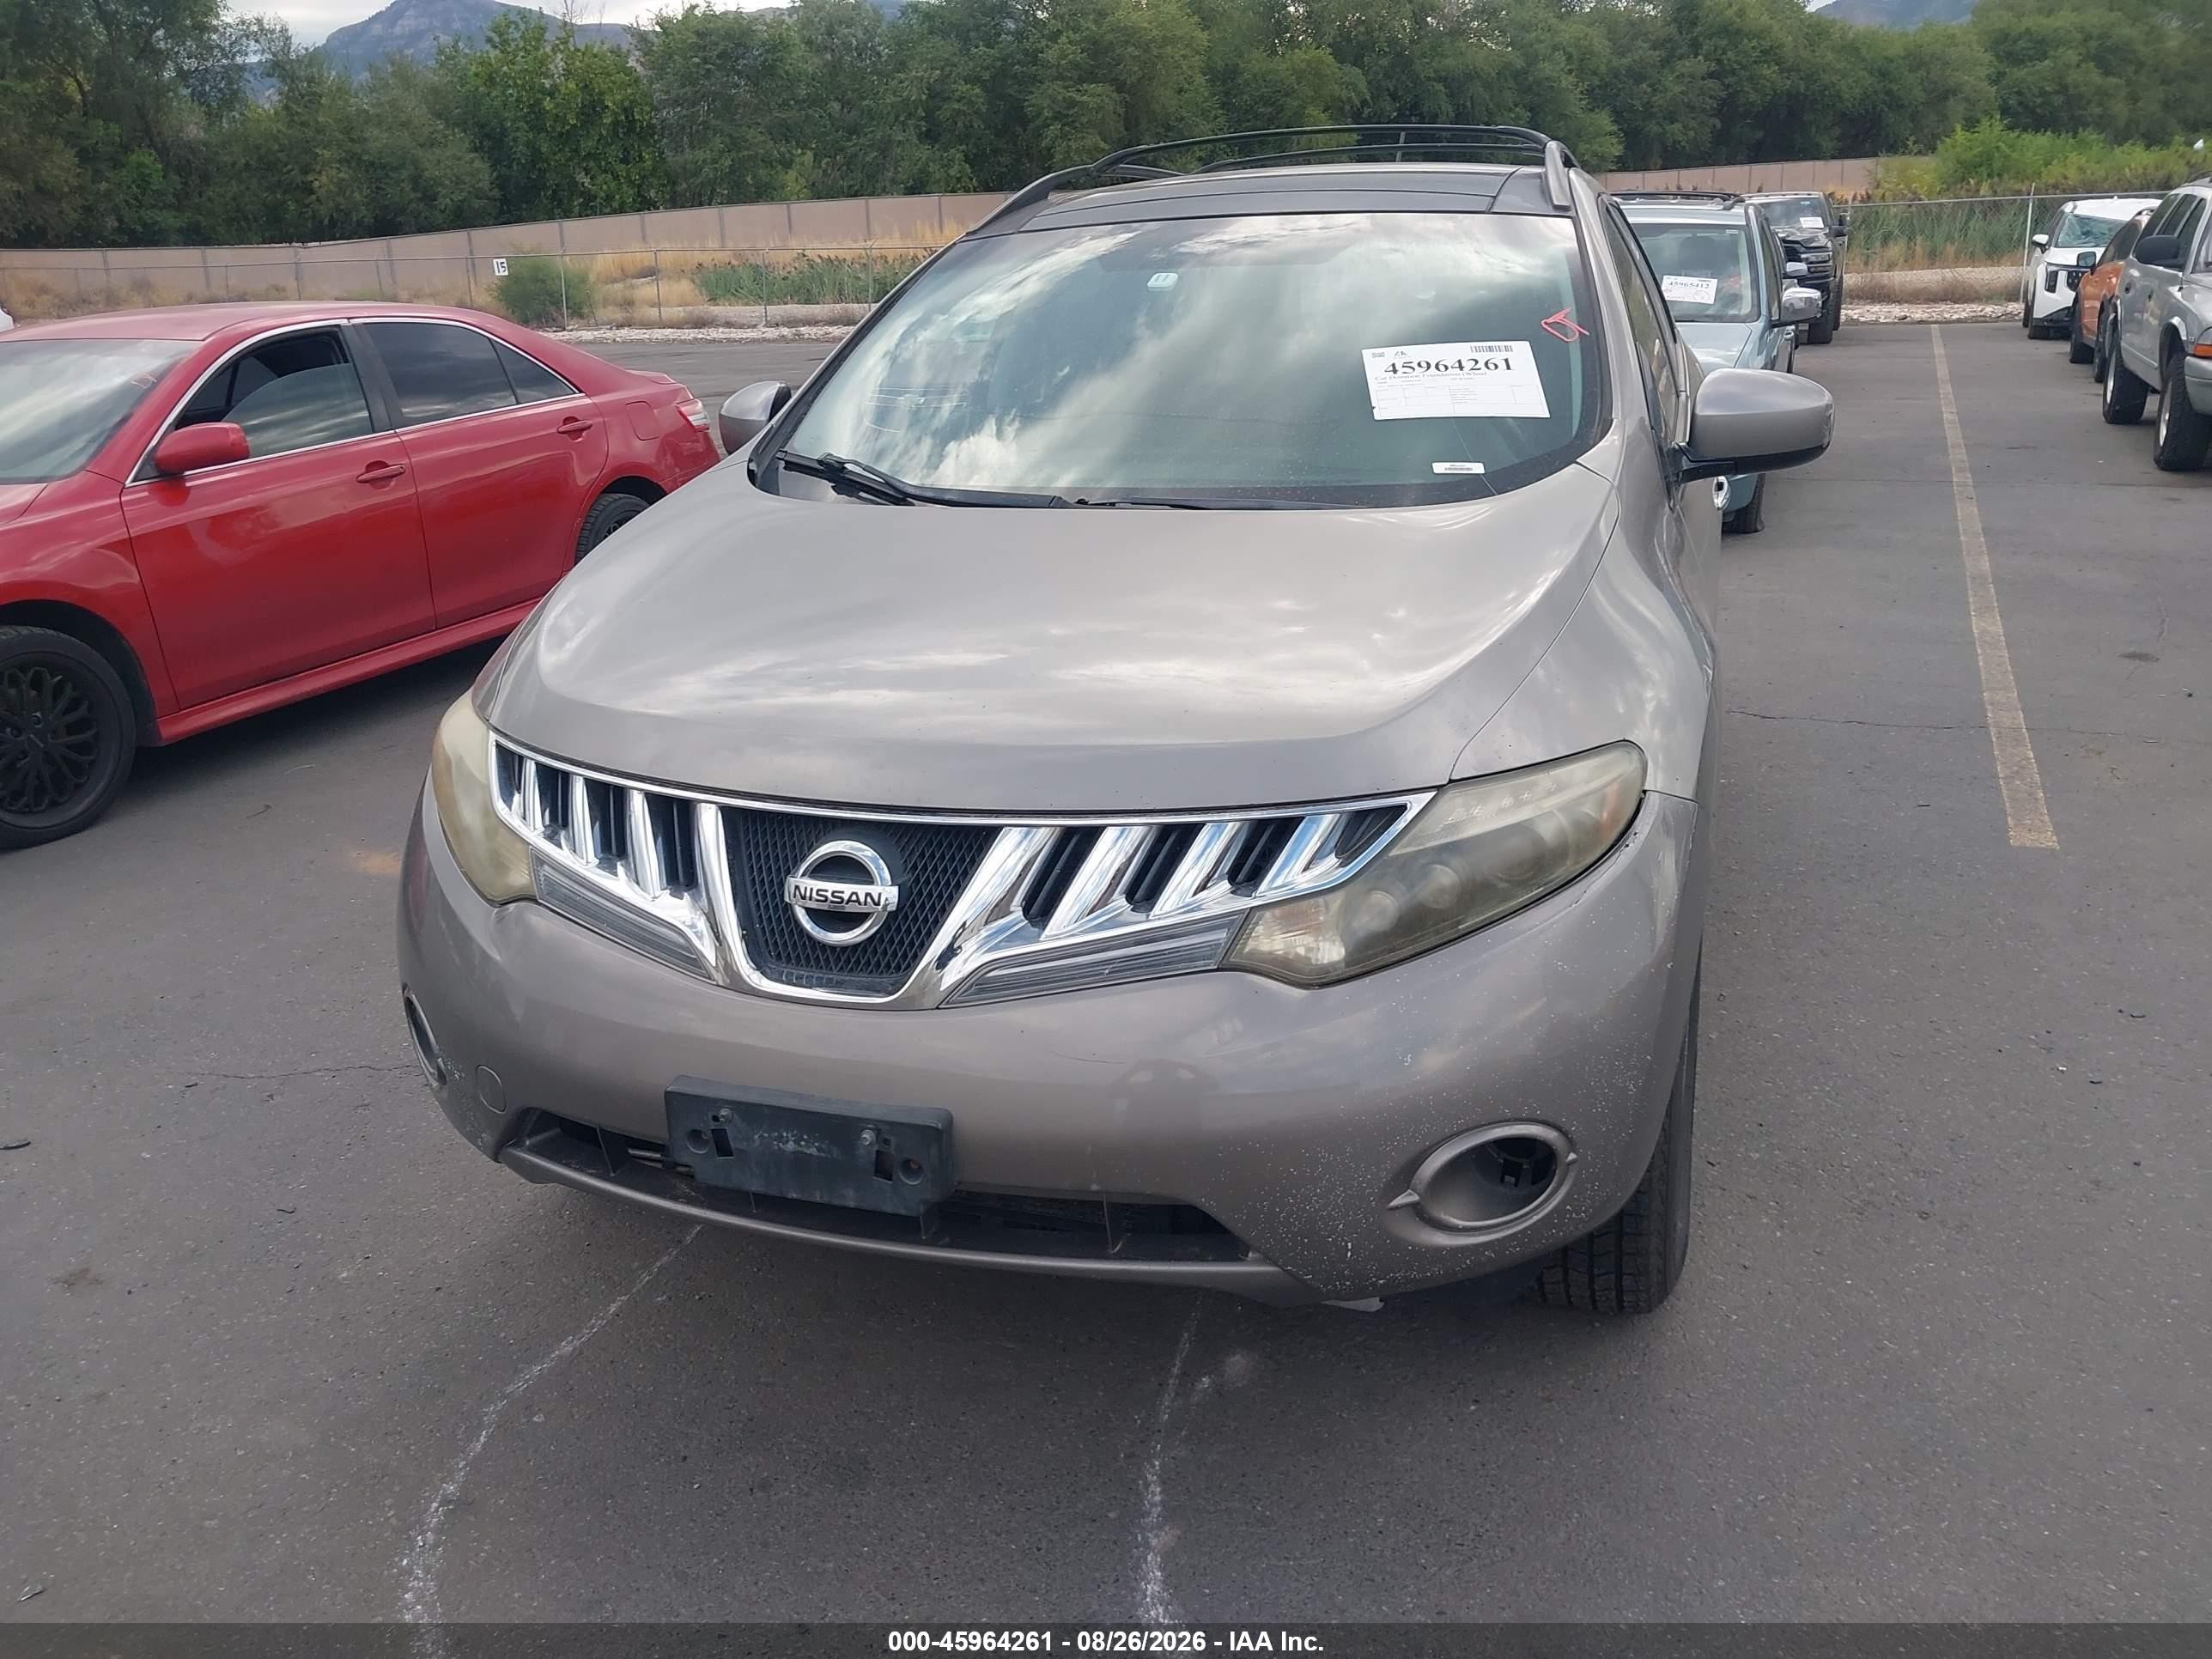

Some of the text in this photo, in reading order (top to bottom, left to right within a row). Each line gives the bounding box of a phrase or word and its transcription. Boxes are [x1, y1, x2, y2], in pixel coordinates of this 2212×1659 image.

[495, 261, 507, 274] 15
[1384, 357, 1515, 374] 45964261
[793, 884, 882, 907] NISSAN
